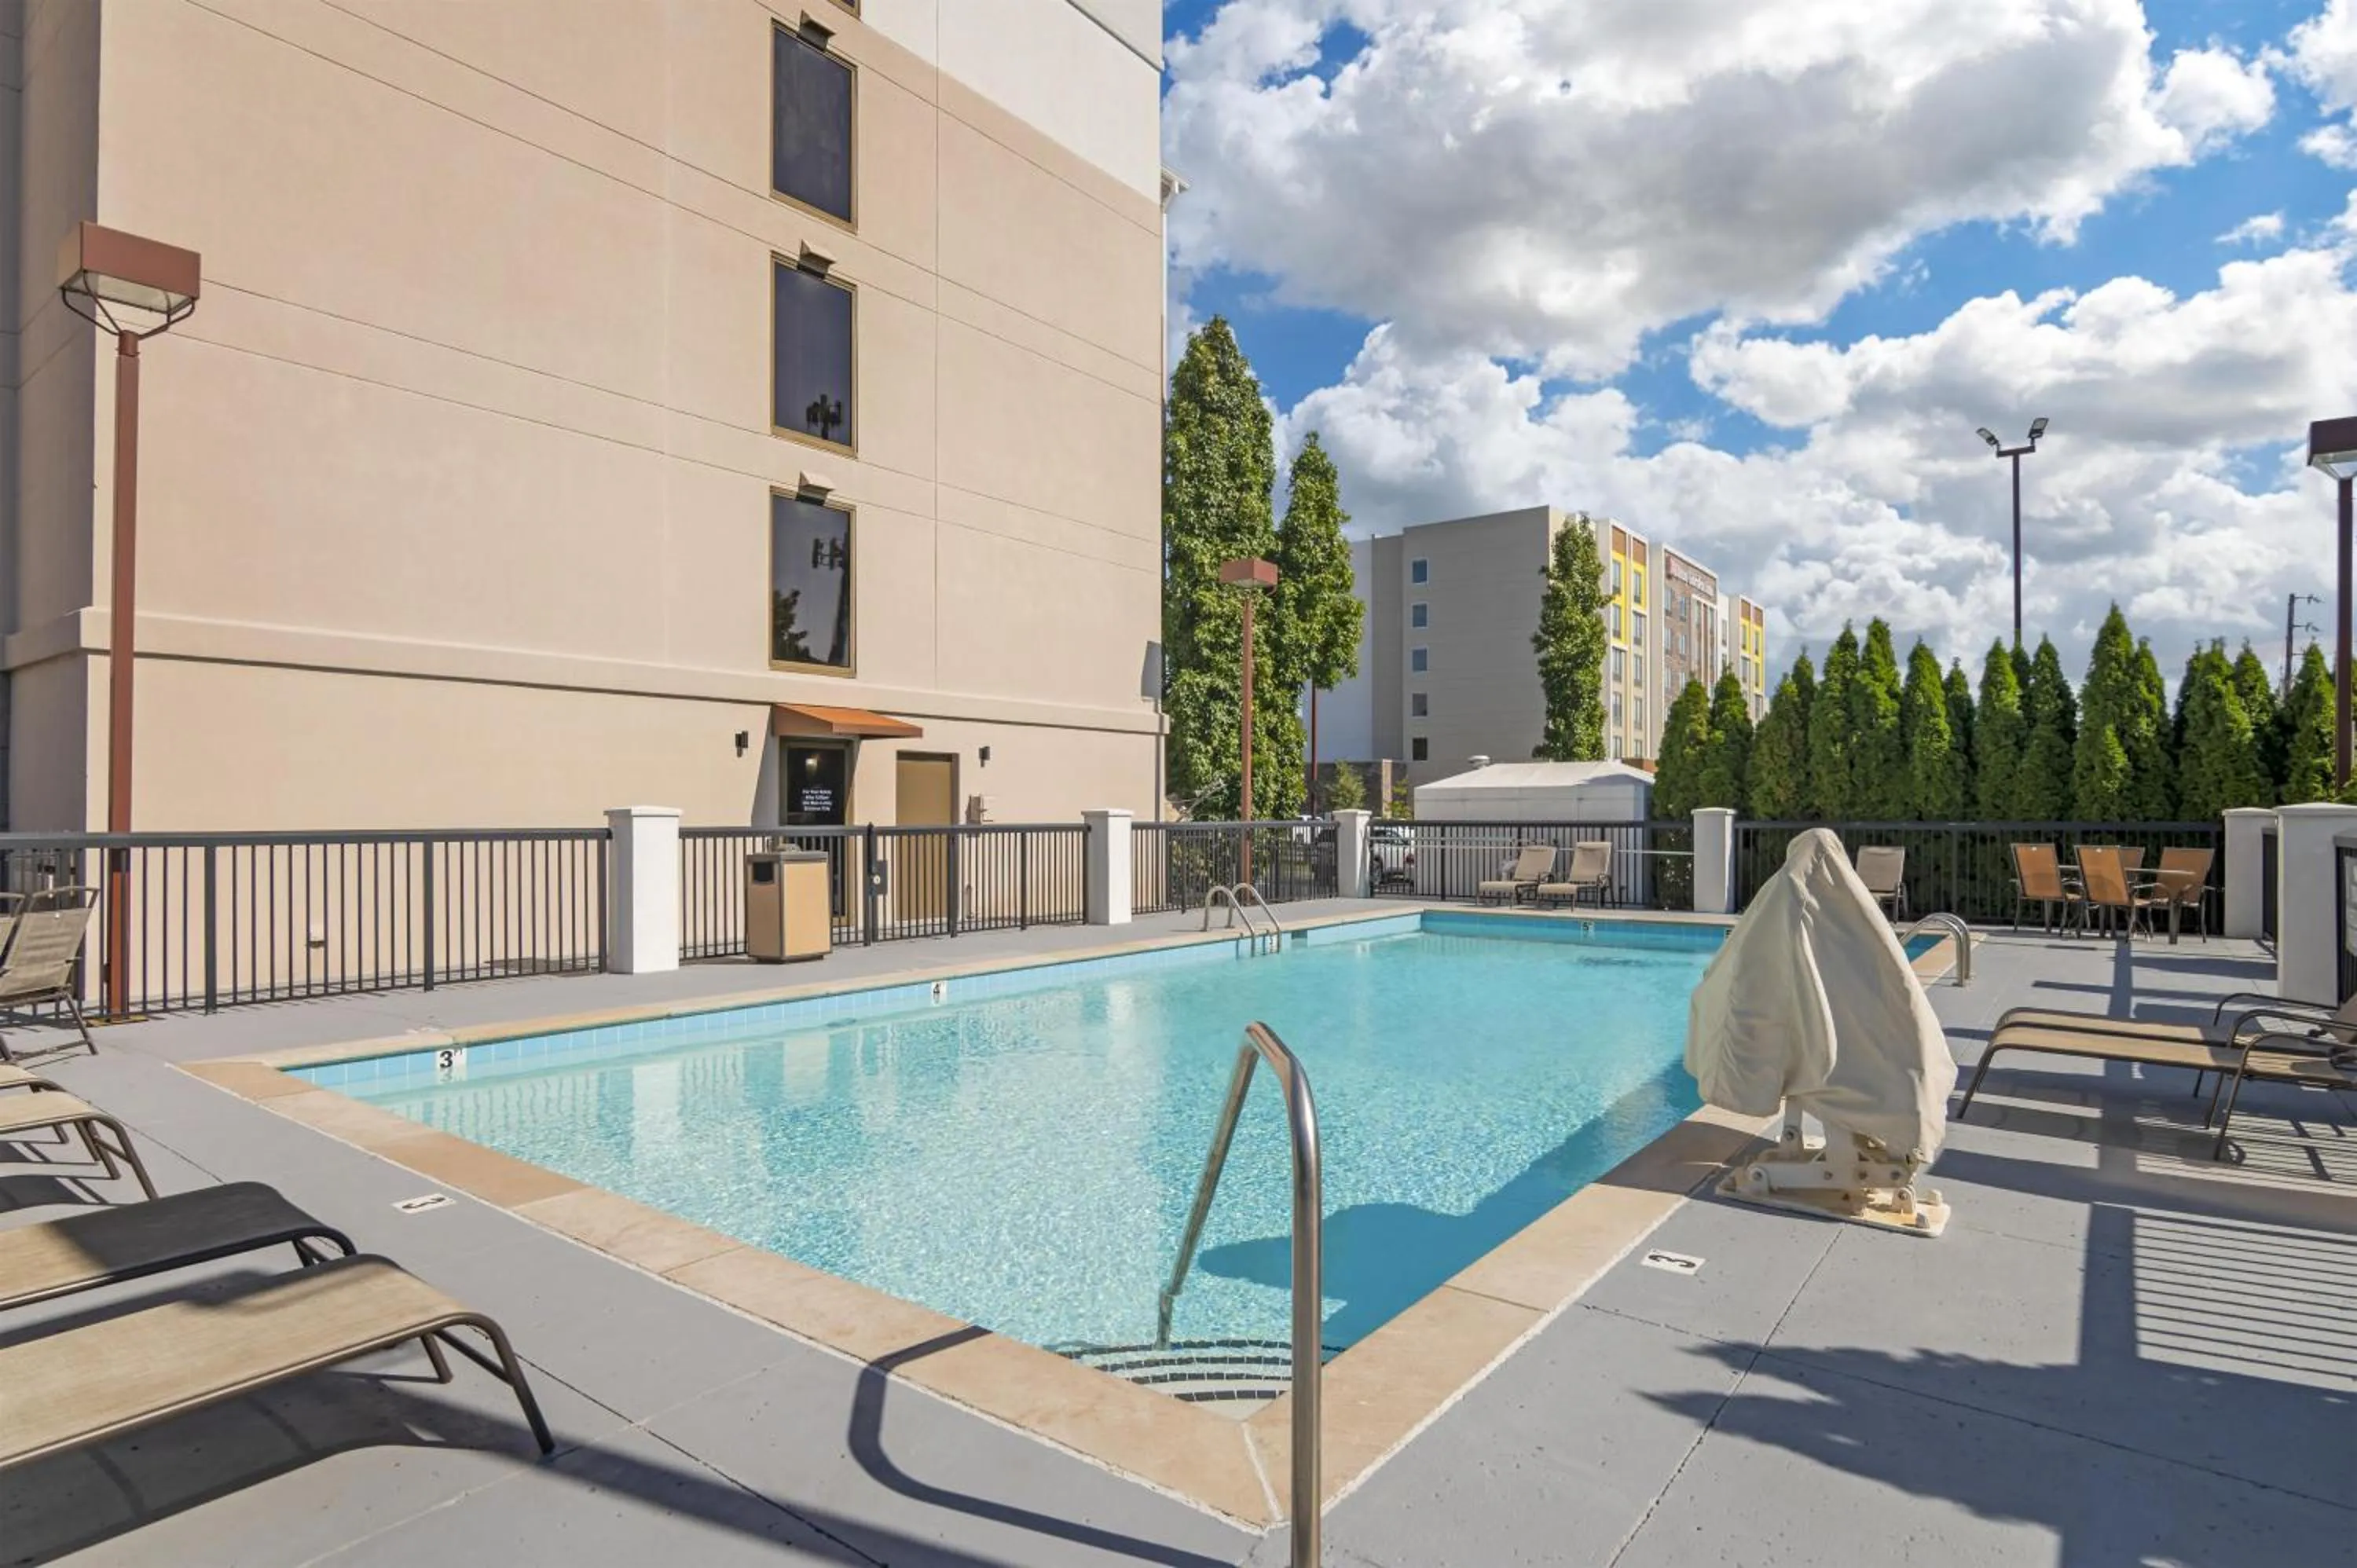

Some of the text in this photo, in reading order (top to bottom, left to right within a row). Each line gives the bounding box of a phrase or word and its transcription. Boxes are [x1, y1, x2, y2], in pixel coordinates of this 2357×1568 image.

[933, 983, 940, 993] 4
[439, 1050, 453, 1068] 3
[1648, 1255, 1696, 1268] 3
